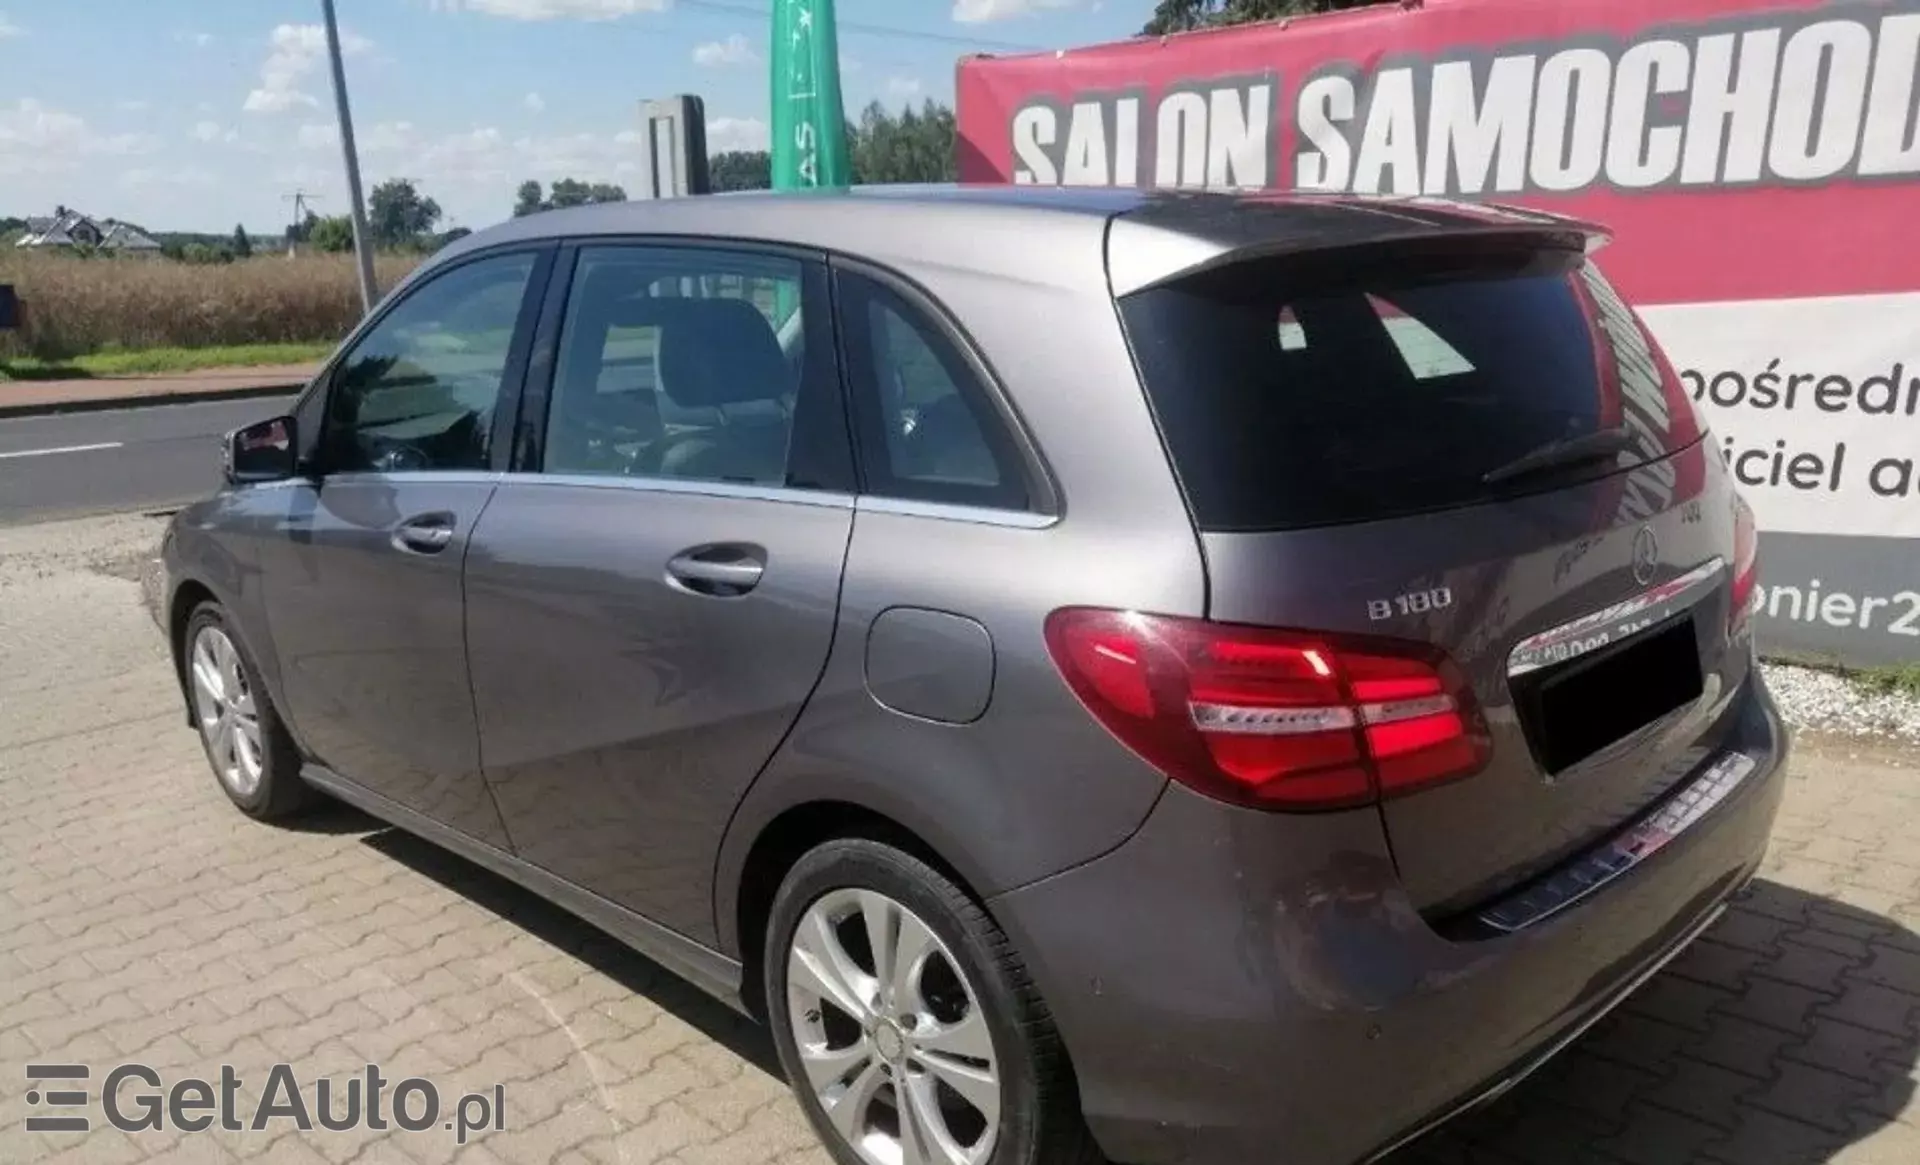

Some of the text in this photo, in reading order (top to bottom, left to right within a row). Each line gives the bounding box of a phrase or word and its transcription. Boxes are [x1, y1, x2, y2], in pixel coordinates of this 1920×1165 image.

[1012, 84, 1271, 189] SALON
[1366, 588, 1452, 620] B 180
